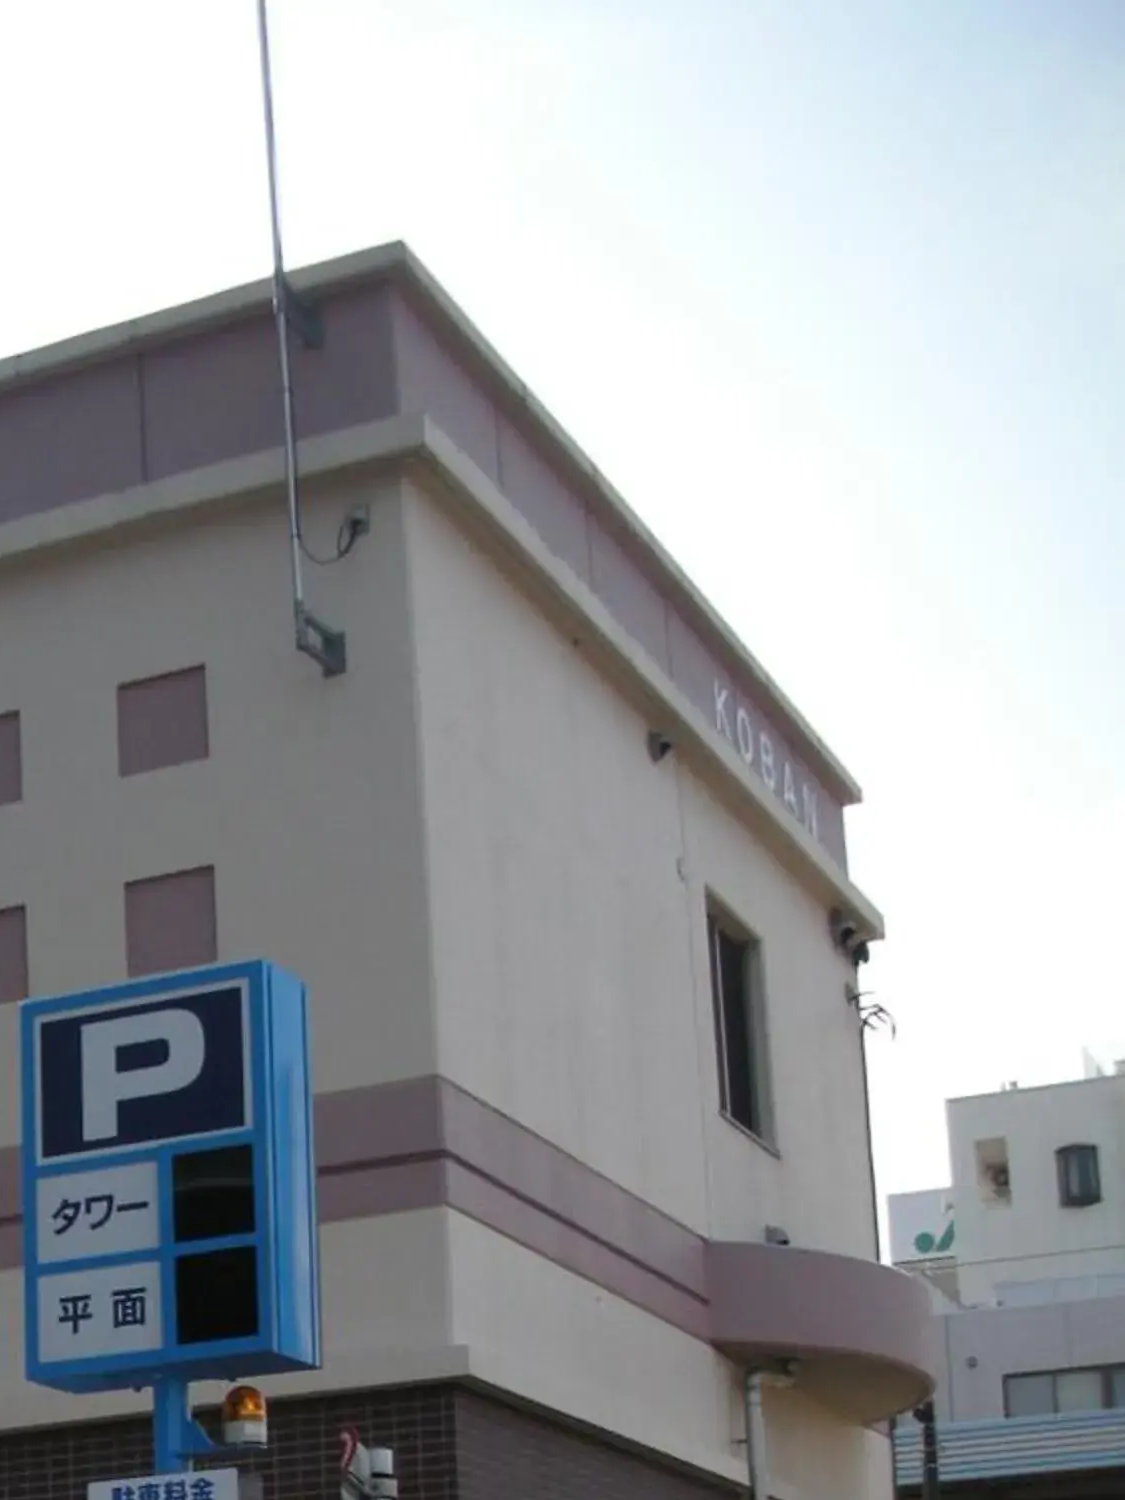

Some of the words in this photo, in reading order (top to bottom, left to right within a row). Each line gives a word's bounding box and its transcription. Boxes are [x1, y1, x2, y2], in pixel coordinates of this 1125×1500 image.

[714, 678, 819, 839] KOBAN
[81, 1008, 205, 1142] P
[52, 1194, 150, 1236] タワー
[58, 1286, 147, 1335] 平面
